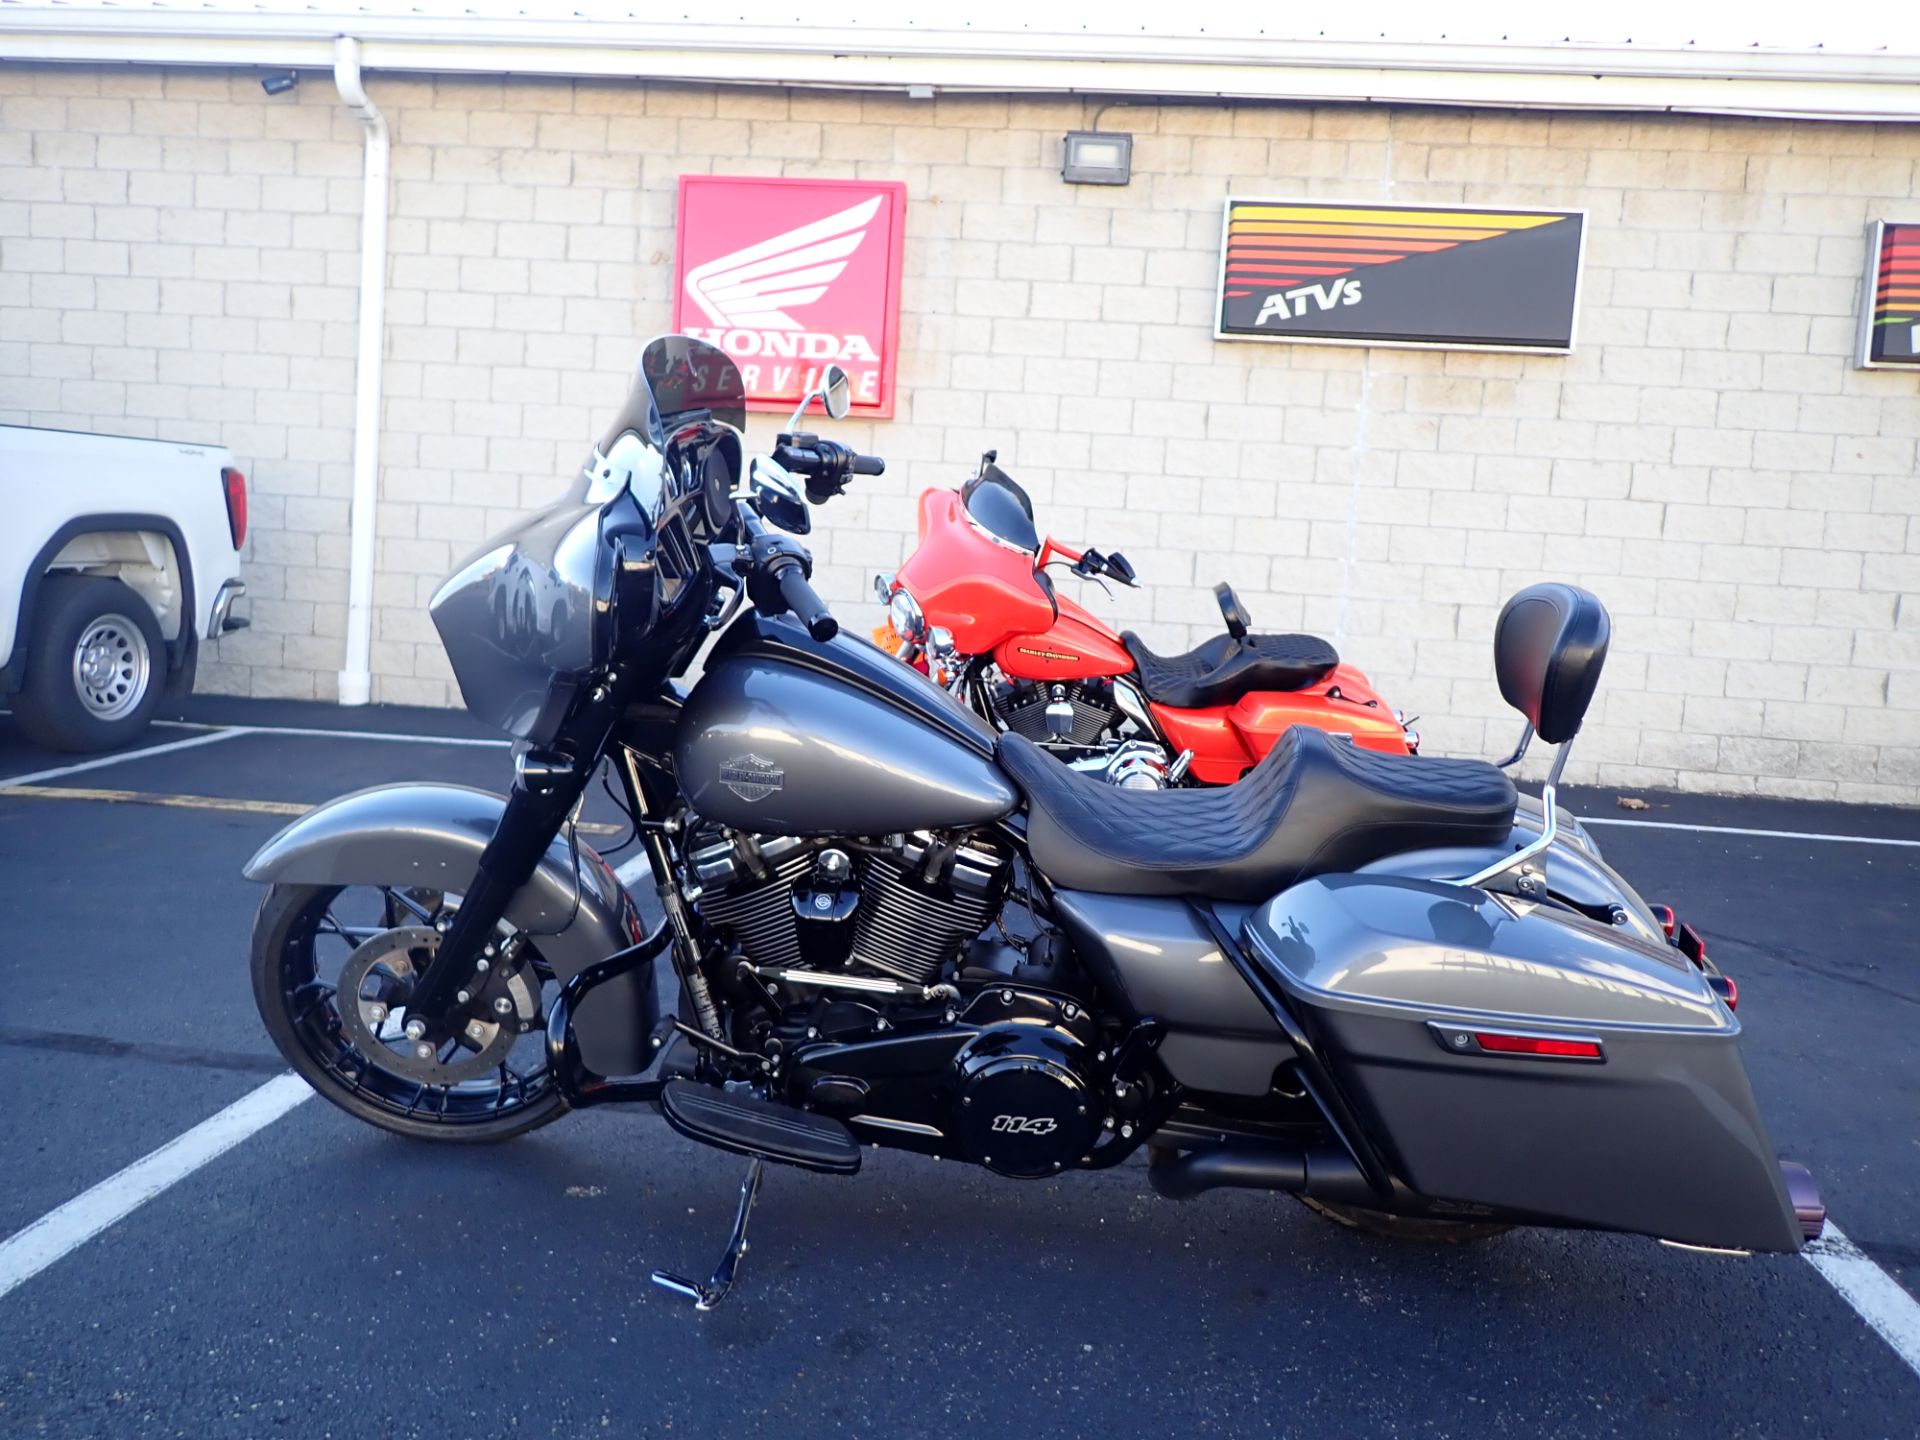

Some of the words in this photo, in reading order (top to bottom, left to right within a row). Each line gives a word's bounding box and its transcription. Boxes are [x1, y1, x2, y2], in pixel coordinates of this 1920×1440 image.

[1255, 278, 1362, 326] ATVs
[683, 327, 880, 361] HONDA
[692, 364, 878, 397] SERVIE
[991, 1114, 1058, 1135] 114
